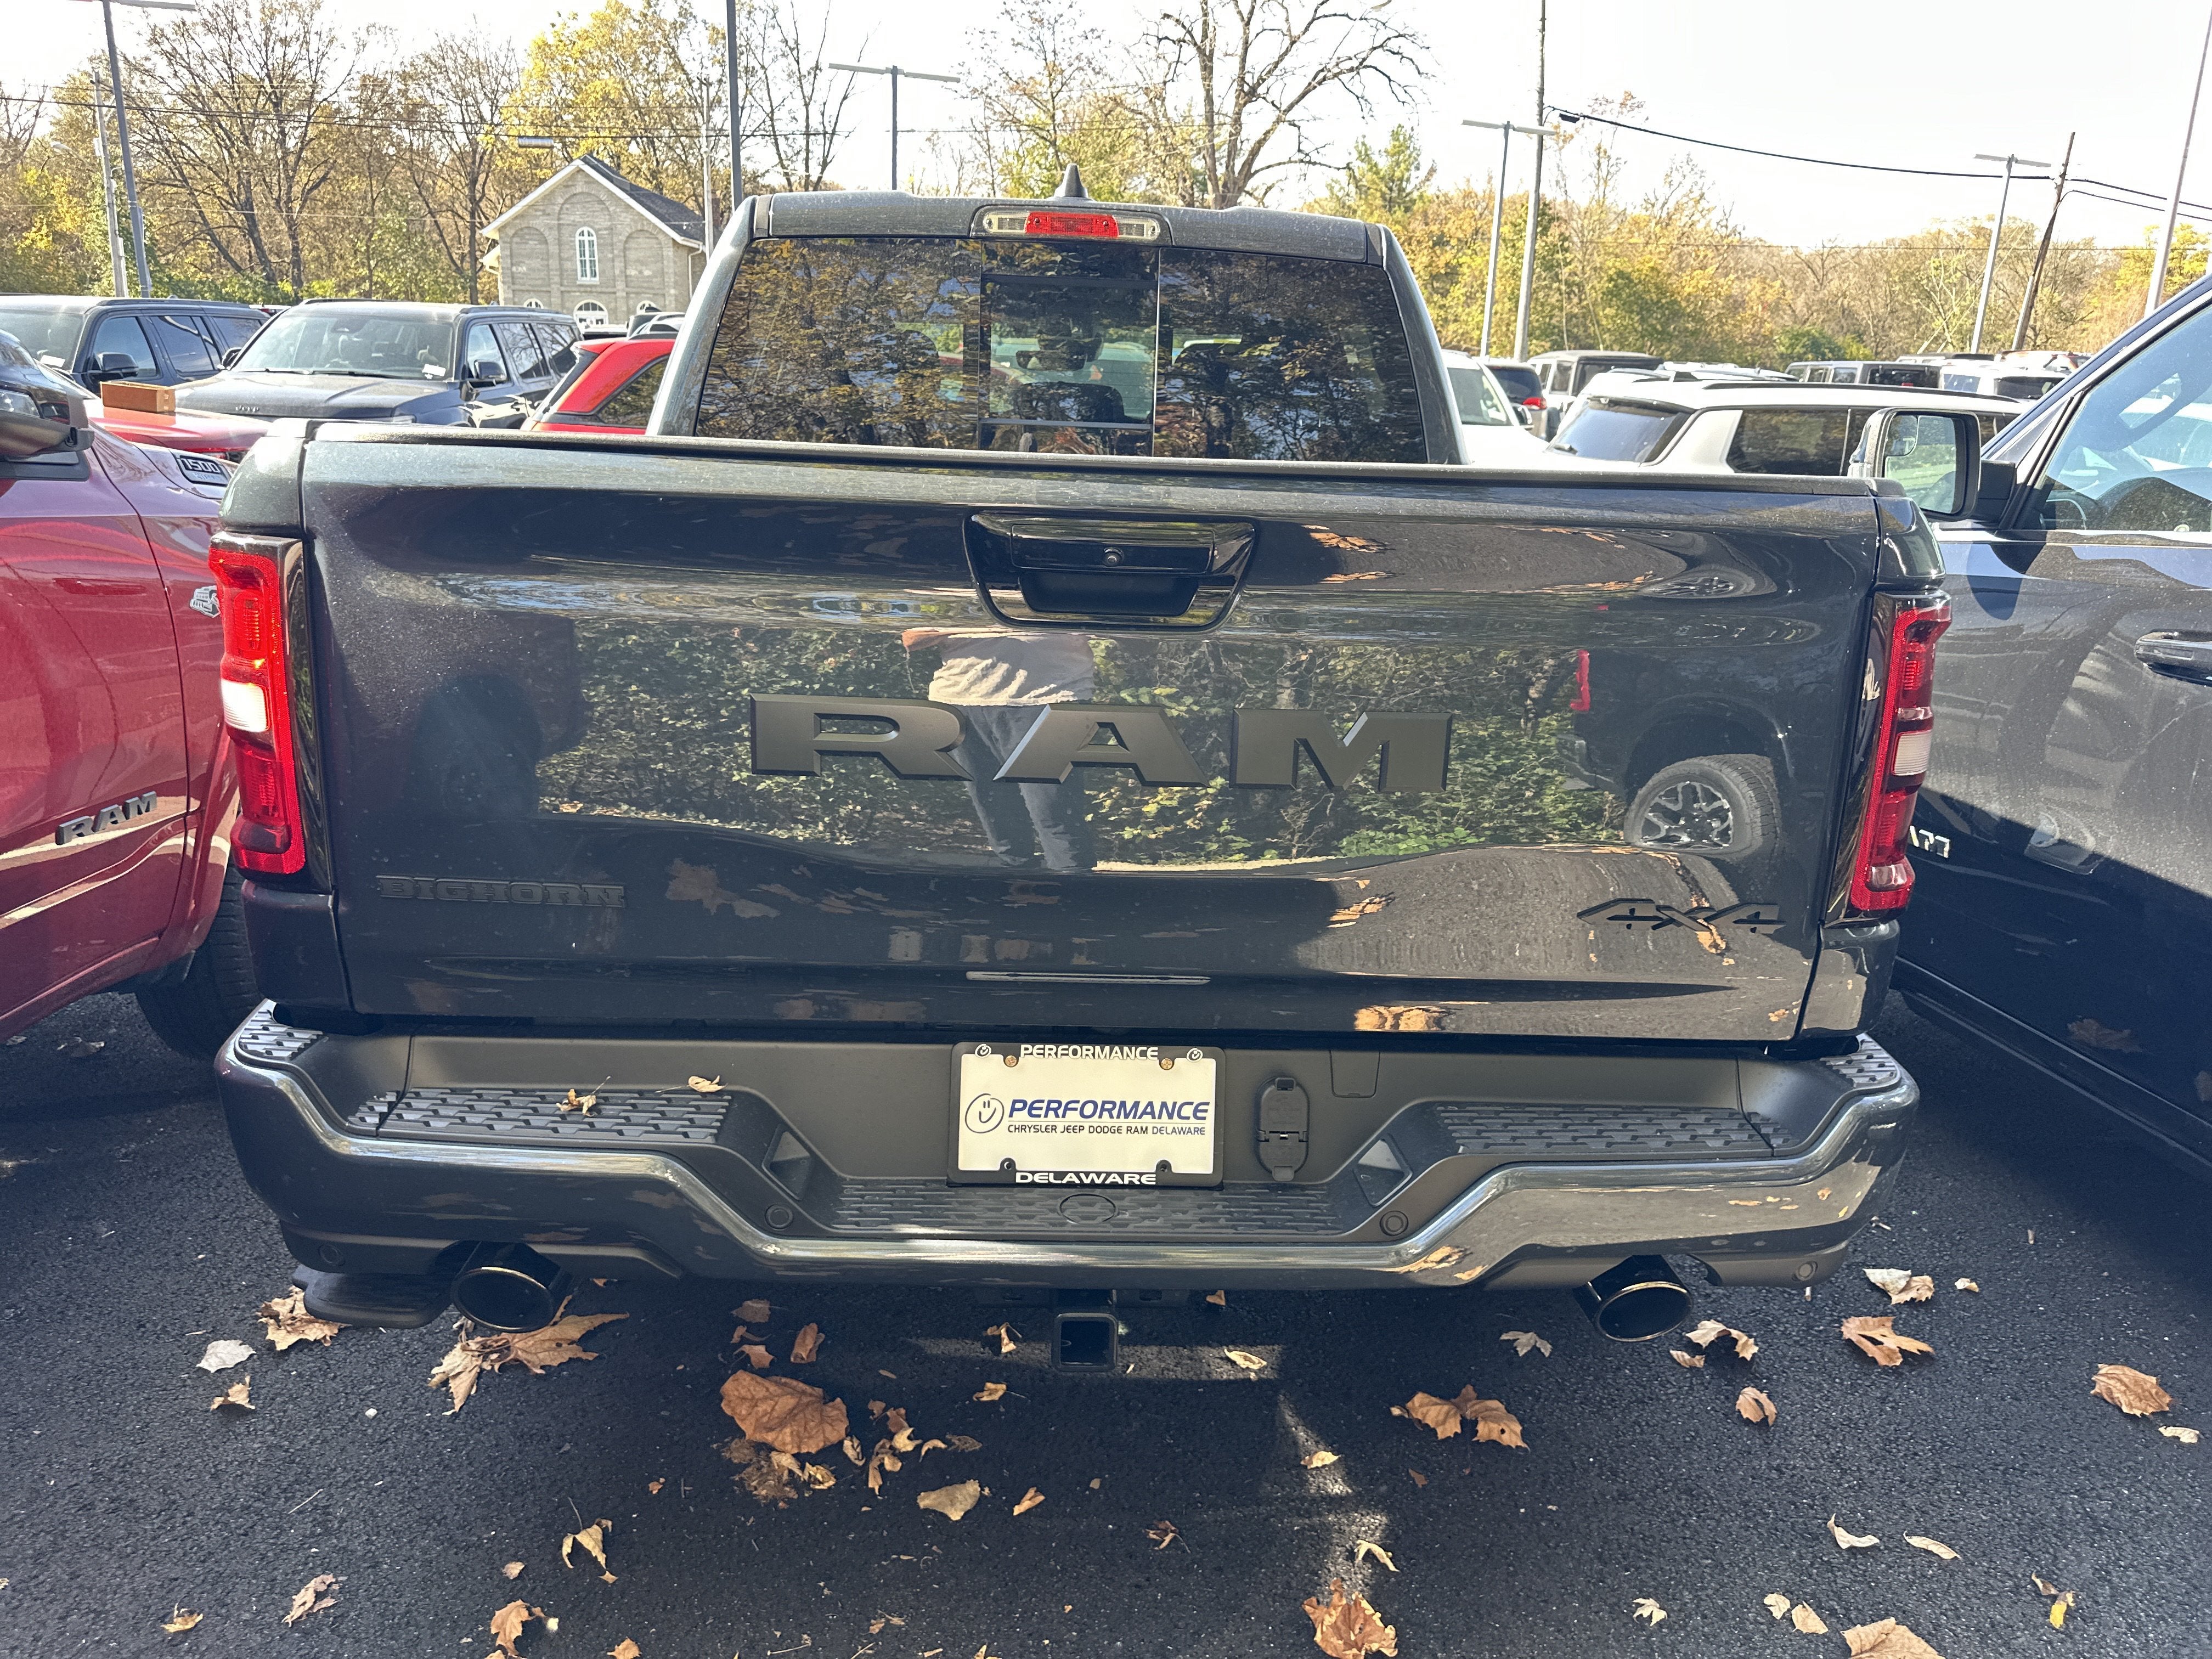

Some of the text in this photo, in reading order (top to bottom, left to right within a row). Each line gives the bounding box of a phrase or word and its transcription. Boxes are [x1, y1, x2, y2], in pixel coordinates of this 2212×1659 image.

[180, 458, 221, 473] 1500
[751, 693, 1453, 792] RAM
[55, 791, 157, 845] RAM
[1020, 1044, 1159, 1060] PERFORMANCE
[1008, 1099, 1210, 1120] PERFORMANCE
[1008, 1124, 1205, 1136] CHRYSLER JEEP DODGE RAM DELAWARE
[1015, 1172, 1156, 1185] DELAWARE
